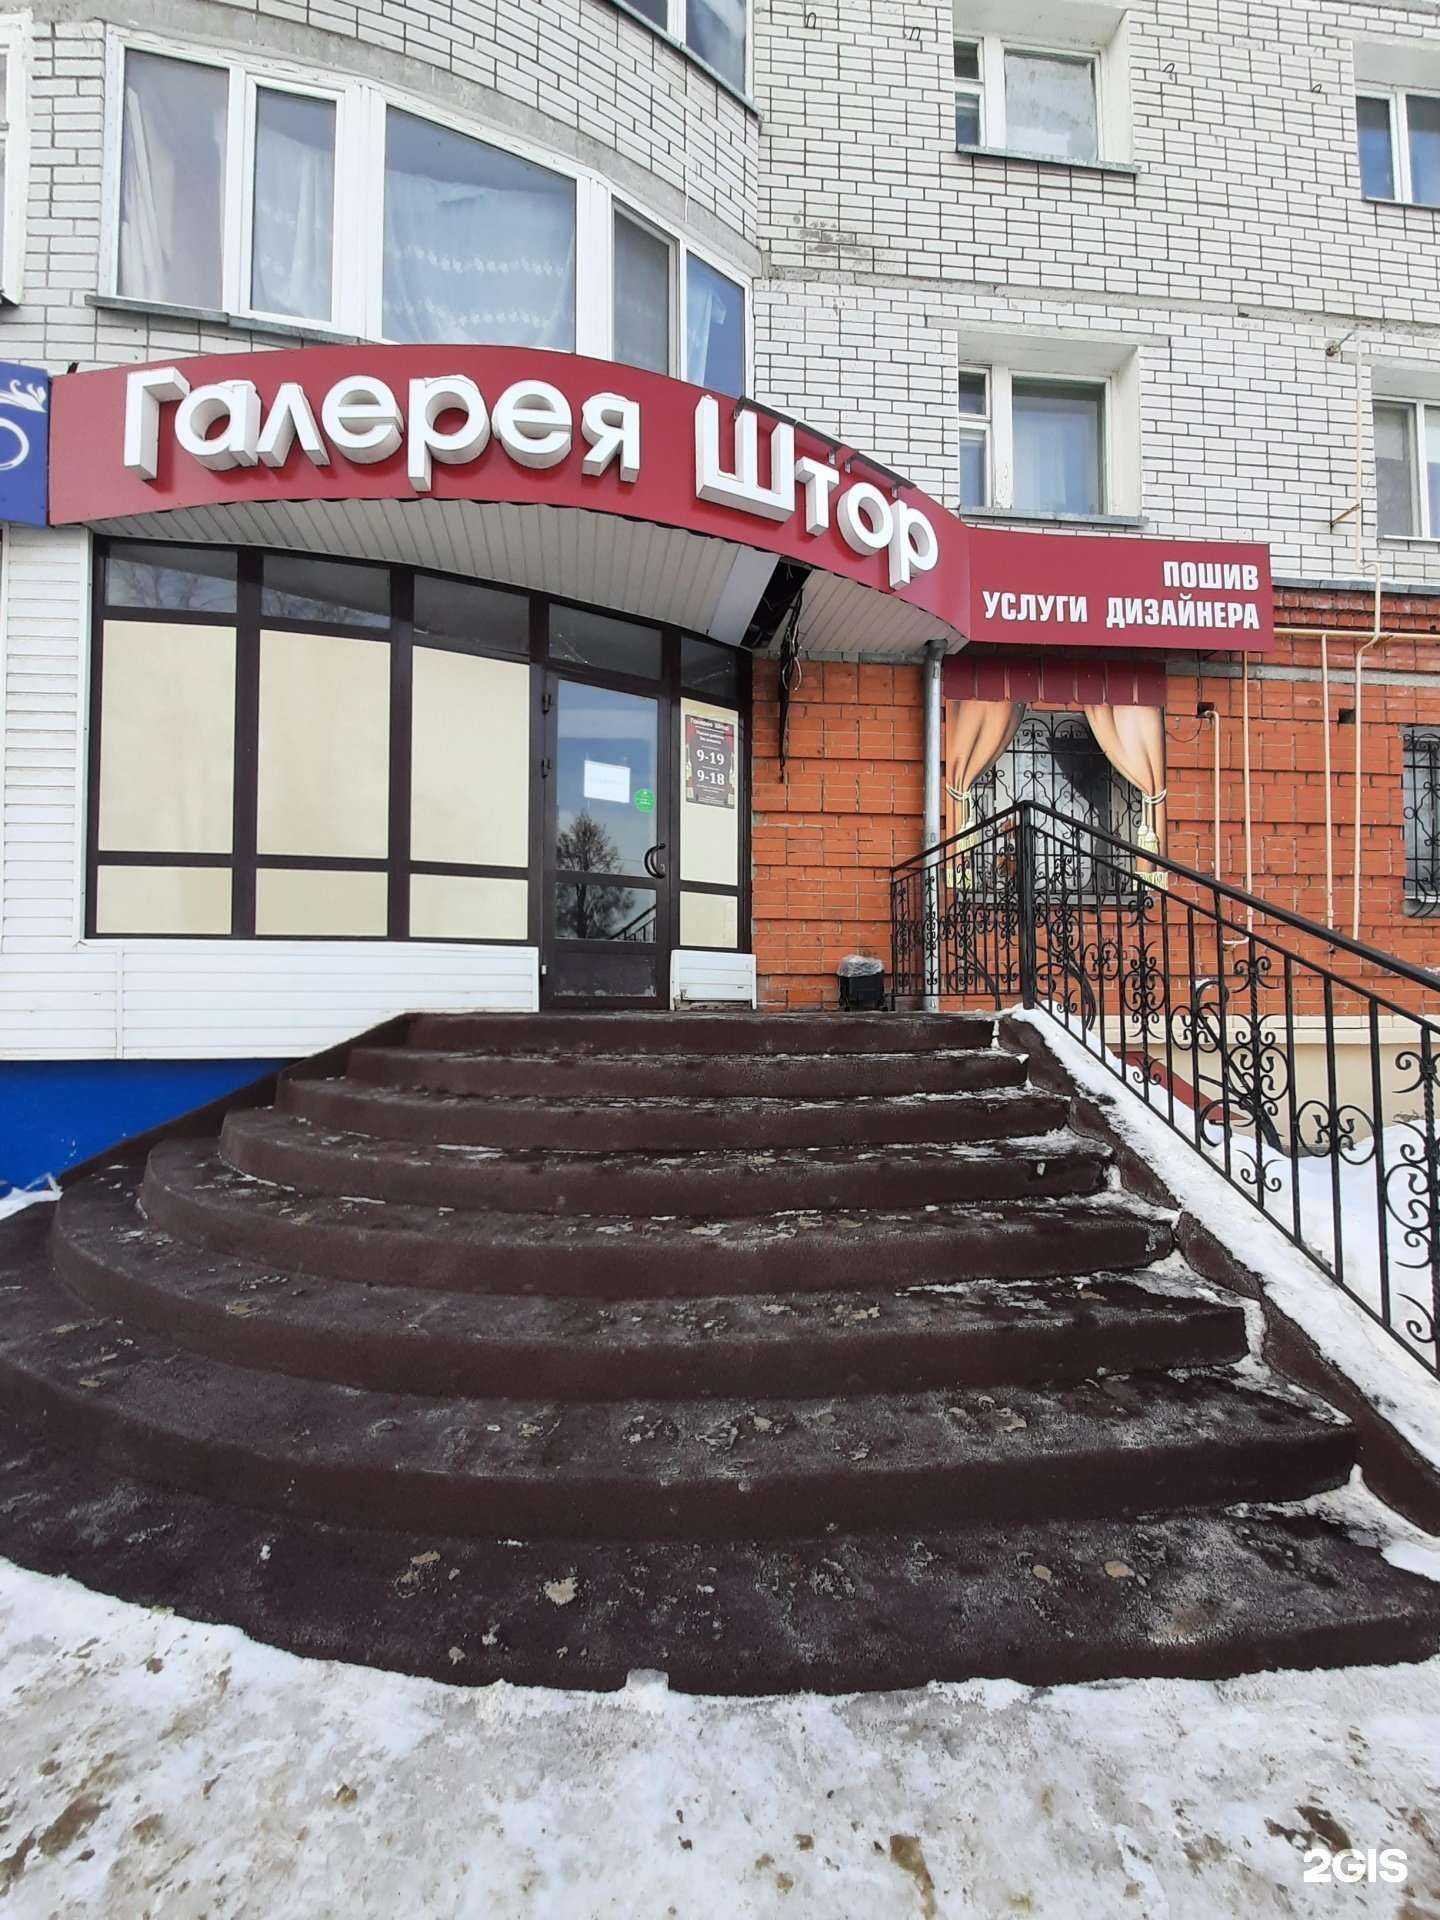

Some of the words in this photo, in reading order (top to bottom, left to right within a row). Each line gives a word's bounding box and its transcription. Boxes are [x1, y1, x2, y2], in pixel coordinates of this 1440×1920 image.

[123, 367, 640, 492] Галерея
[695, 395, 938, 589] Штор
[1163, 560, 1259, 591] ПОШИВ
[982, 590, 1088, 623] УСЛУГИ
[1106, 593, 1260, 630] ДИЗАЙНЕРА
[696, 749, 725, 765] 9-19
[696, 769, 725, 786] 9-18
